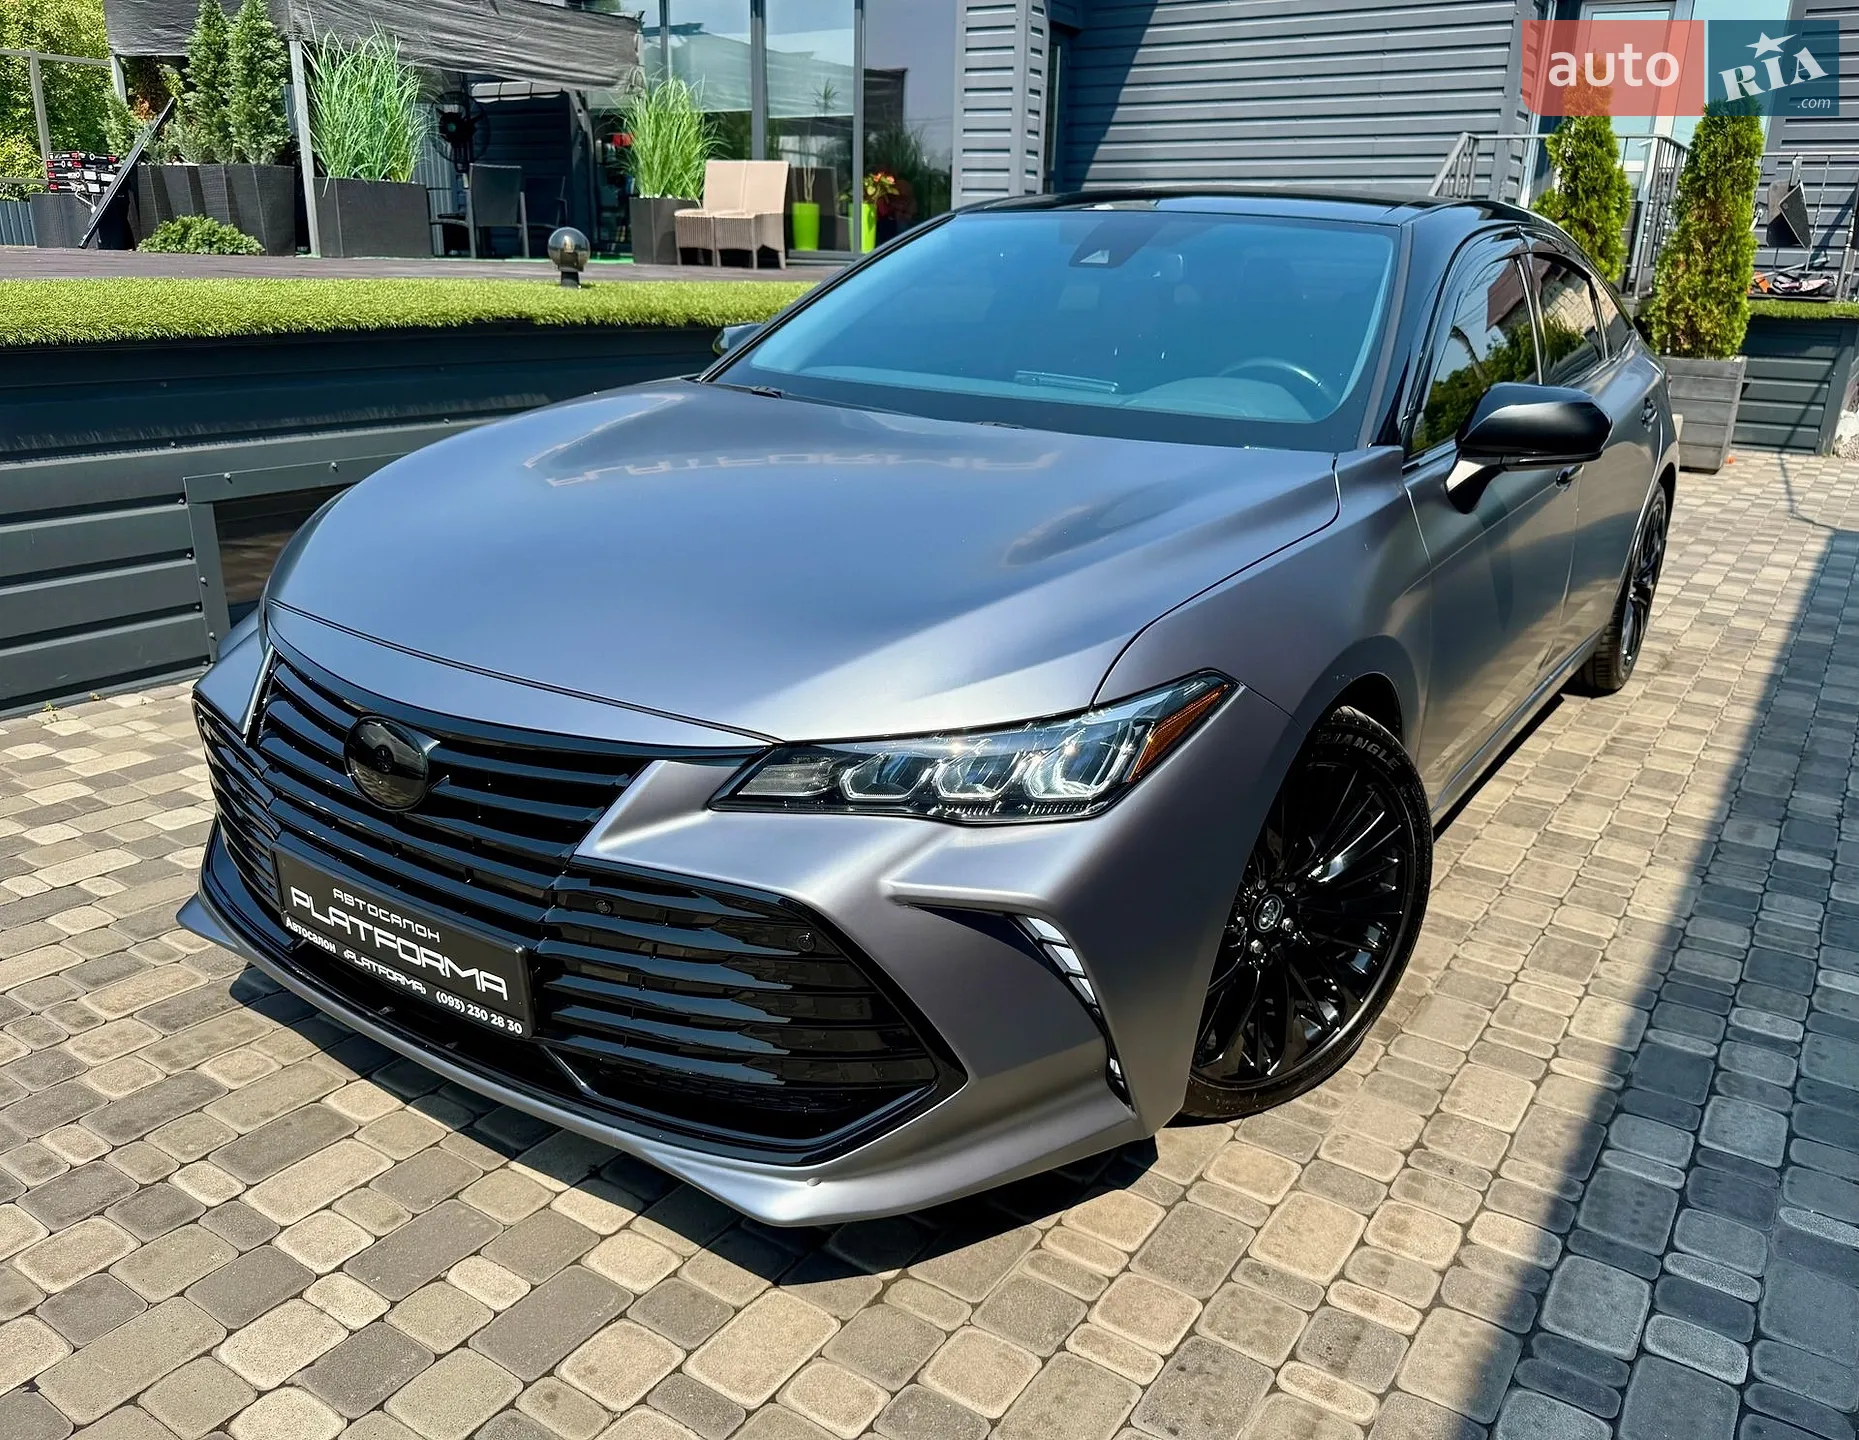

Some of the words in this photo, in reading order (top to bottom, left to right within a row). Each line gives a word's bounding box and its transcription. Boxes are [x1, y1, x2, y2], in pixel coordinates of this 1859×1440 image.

[290, 886, 508, 1001] PLATFORMA
[332, 887, 440, 943] АВТОСАЛОН
[285, 916, 337, 954] Автосалон
[435, 990, 465, 1013] (093)
[467, 1003, 488, 1022] 230
[490, 1013, 505, 1028] 28
[506, 1019, 522, 1035] 30
